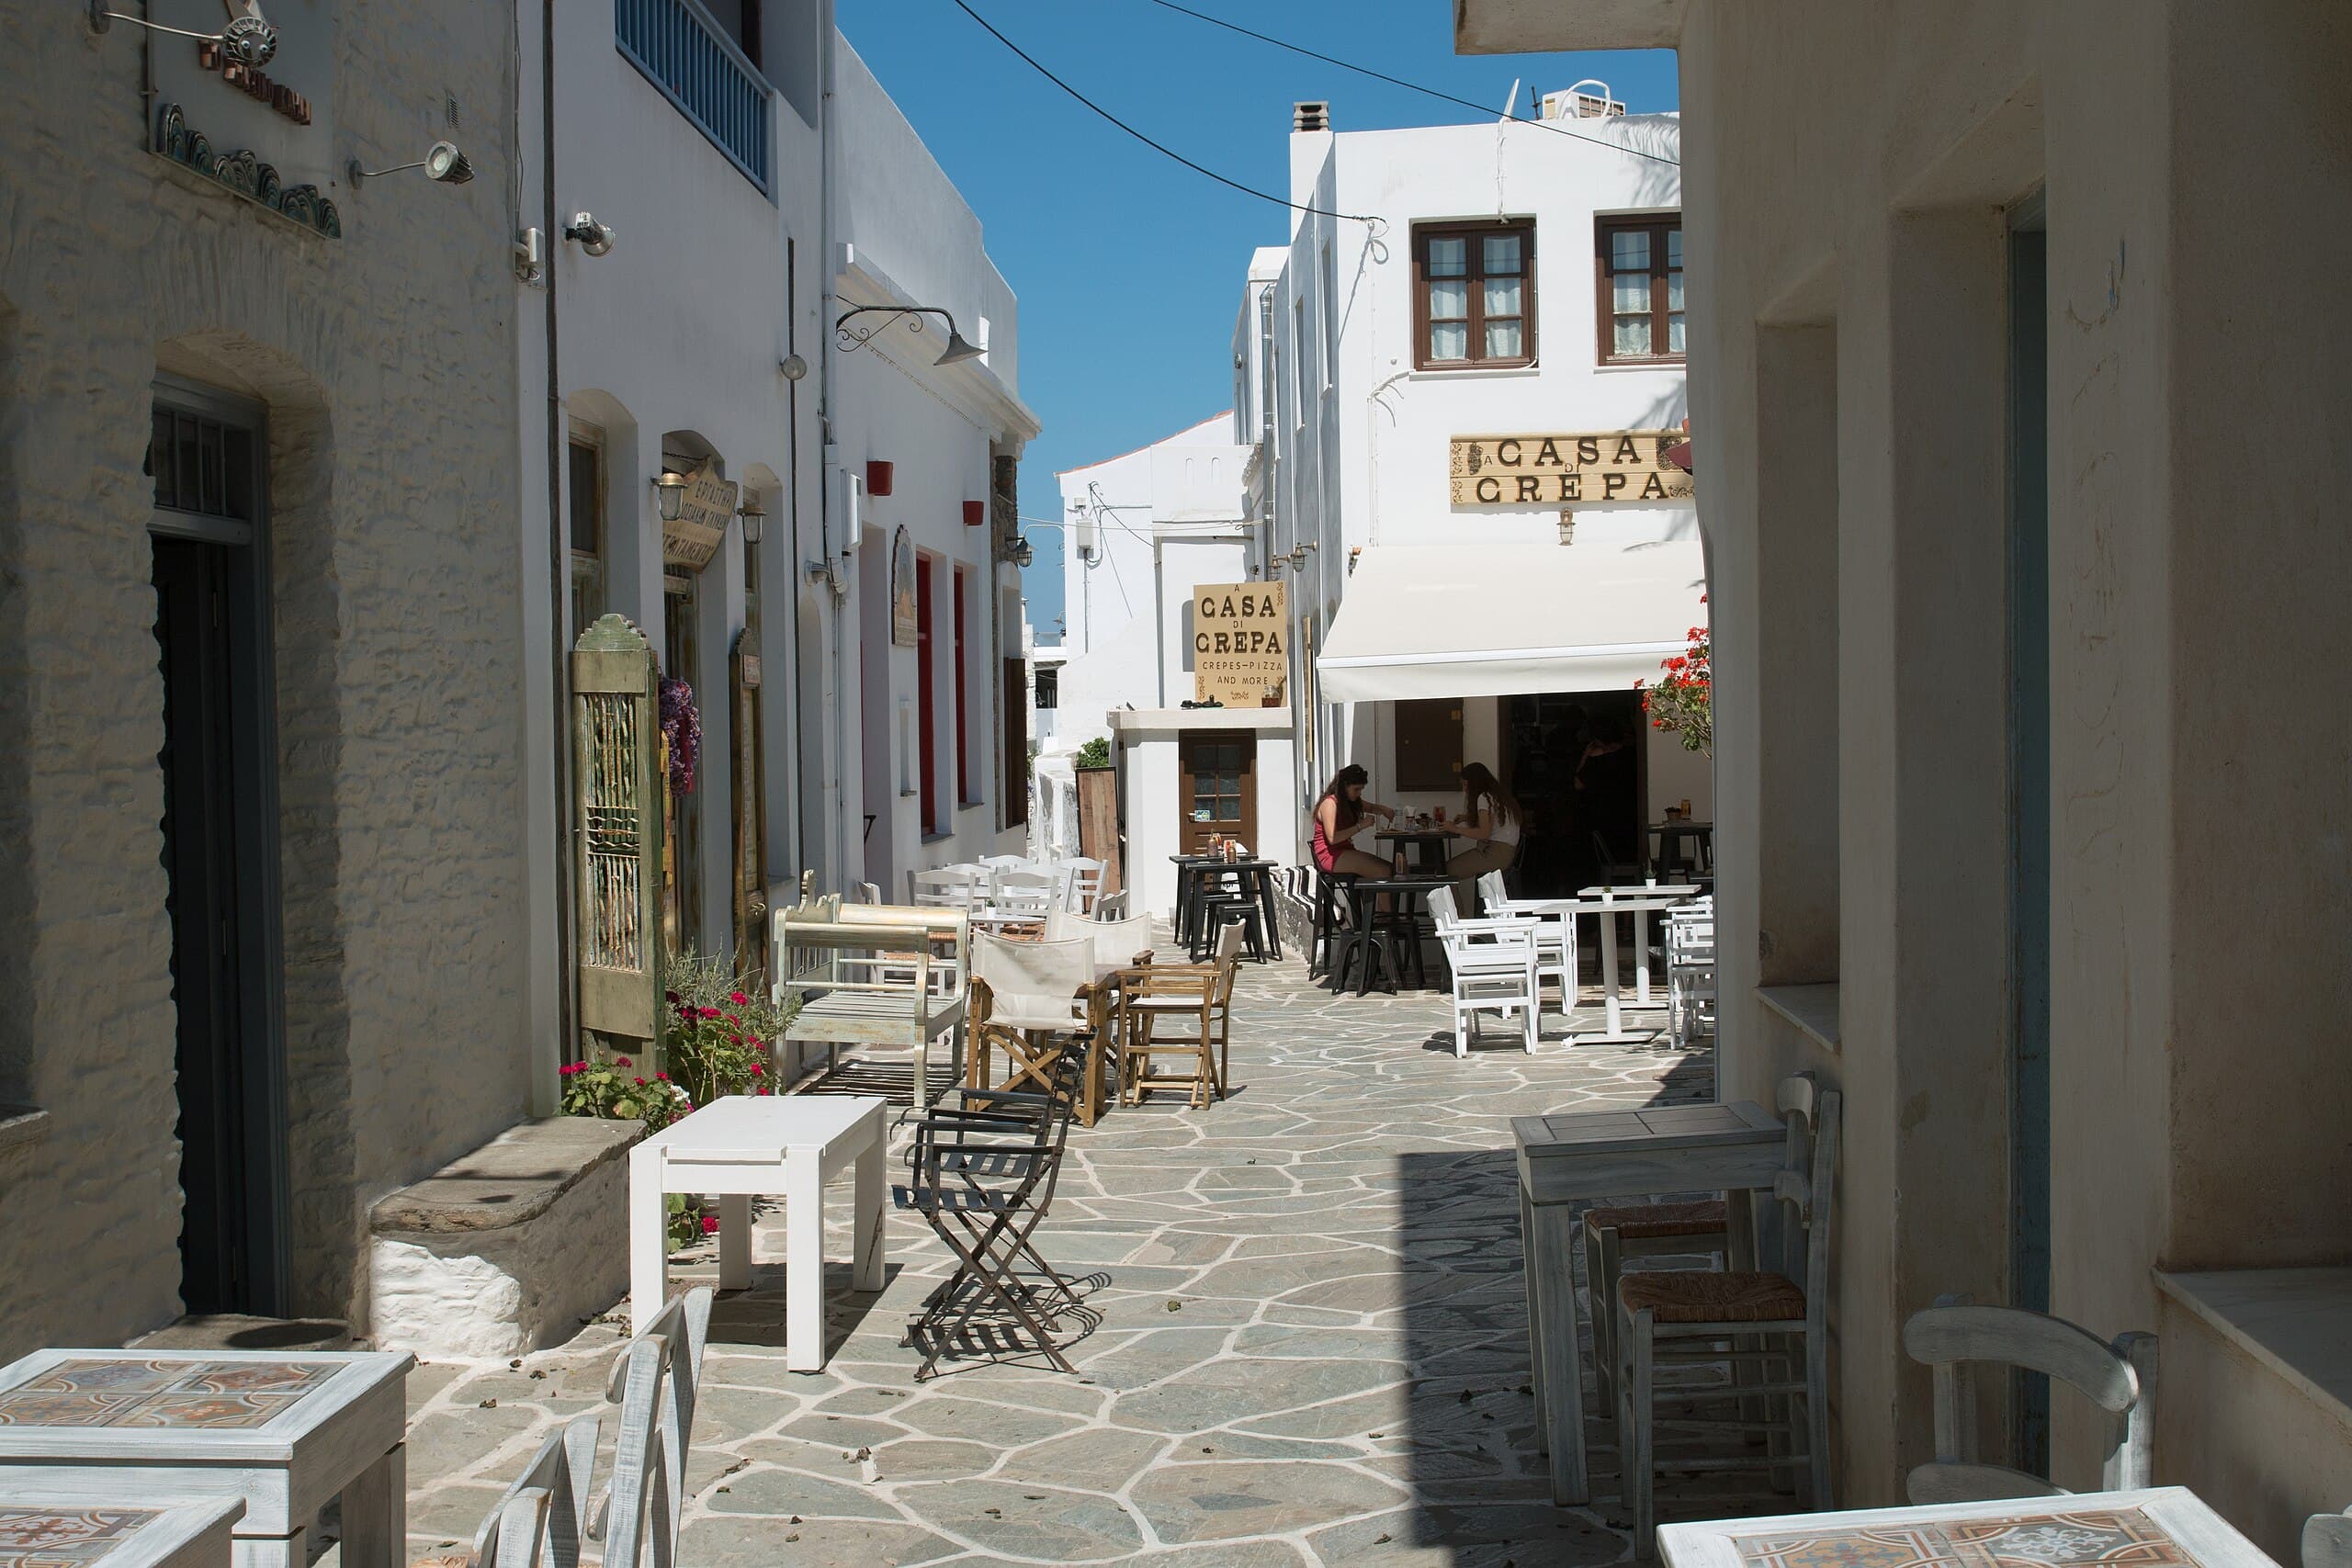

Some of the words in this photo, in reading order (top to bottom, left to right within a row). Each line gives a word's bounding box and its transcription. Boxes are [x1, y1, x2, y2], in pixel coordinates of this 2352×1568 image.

[1484, 455, 1493, 466] A
[1498, 434, 1642, 468] CASA
[1565, 461, 1580, 473] DI
[1476, 471, 1669, 503] CREPA
[1234, 583, 1240, 592] A
[1200, 594, 1277, 618] CASA
[1232, 620, 1243, 628] DI
[1195, 631, 1283, 655] CREPA
[1216, 675, 1237, 684] AND
[1241, 675, 1269, 685] MORE
